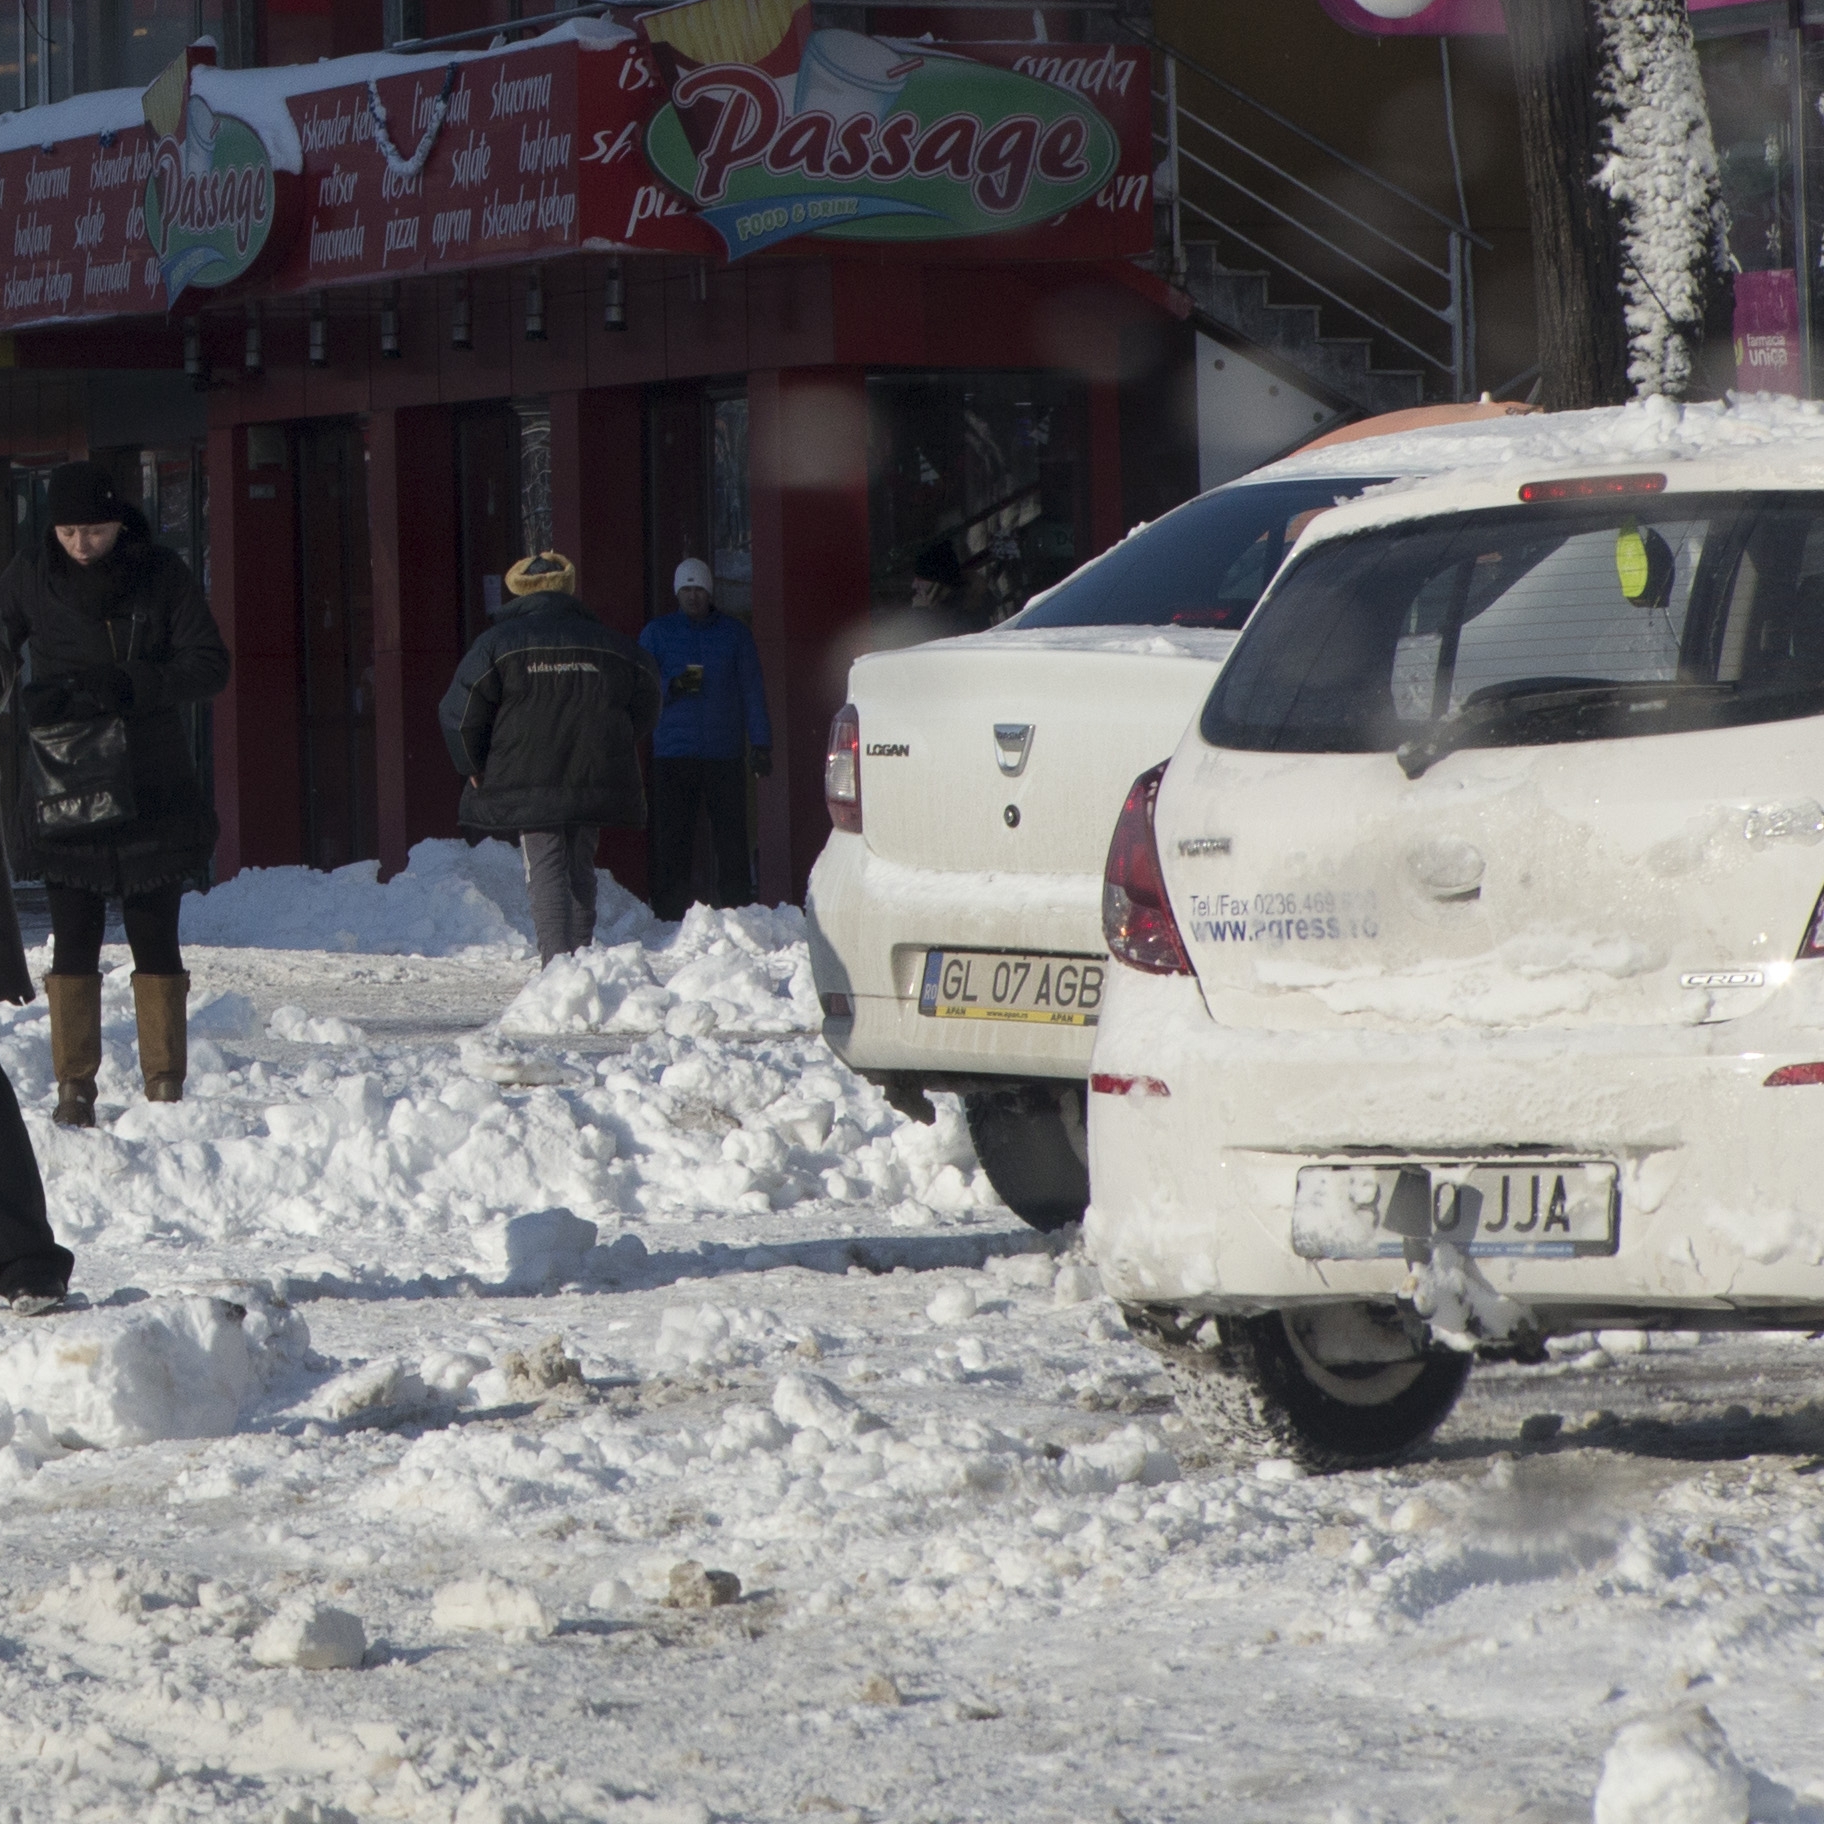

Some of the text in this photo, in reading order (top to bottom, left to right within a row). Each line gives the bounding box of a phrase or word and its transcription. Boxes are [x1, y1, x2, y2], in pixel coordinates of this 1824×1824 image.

[1012, 44, 1137, 97] onada
[303, 100, 351, 153] iskender
[352, 96, 381, 153] keb
[411, 72, 471, 136] limada
[490, 62, 553, 120] shaorma
[449, 129, 492, 191] salate
[518, 118, 572, 175] baklava
[672, 62, 1091, 215] Passage
[24, 156, 72, 204] shaorma
[90, 141, 133, 191] iskender
[153, 133, 267, 257] Passage
[14, 211, 52, 259] baklava
[72, 197, 105, 250] salate
[125, 189, 145, 243] des
[309, 178, 576, 271] limonada pizza ayran iskender kebap
[735, 197, 859, 241] FOOD & DRINK
[3, 263, 43, 310] iskender
[43, 259, 73, 312] kebap
[83, 245, 132, 302] limonada
[867, 744, 909, 757] LOGAN
[1190, 895, 1249, 917] Tel./Fax
[1190, 917, 1379, 950] www.agressro
[924, 959, 1104, 1008] RO GL 07 AGB
[945, 1006, 966, 1016] APAN
[1050, 1013, 1073, 1022] APAN
[1484, 1175, 1571, 1233] JJA
